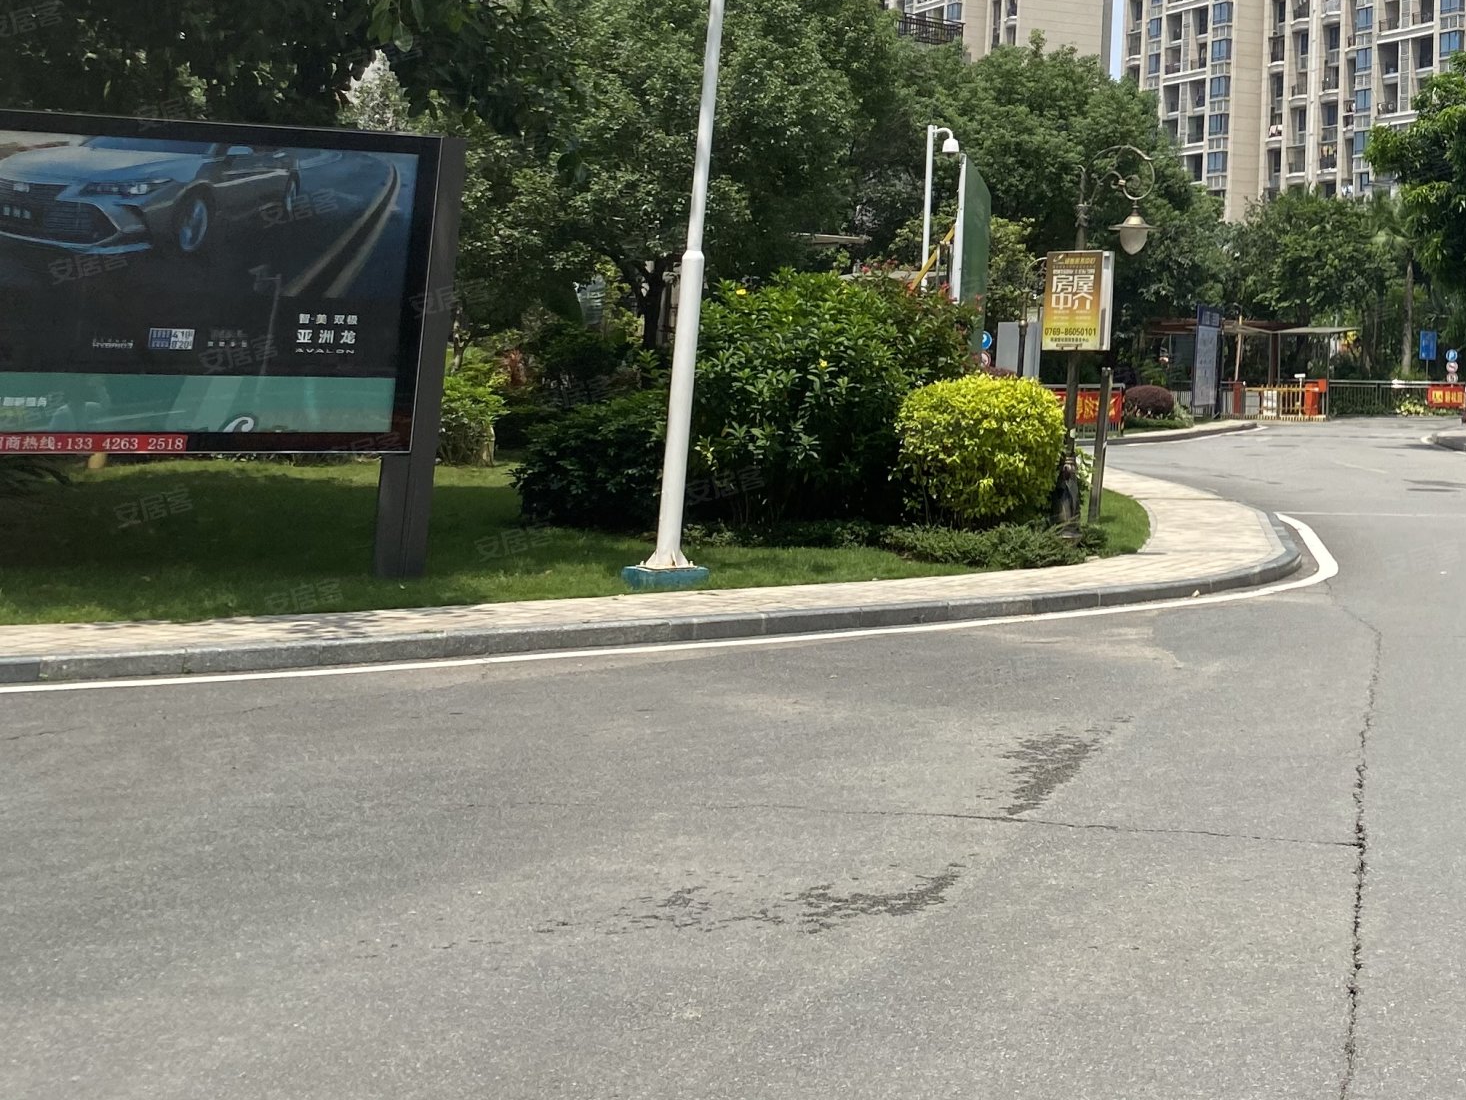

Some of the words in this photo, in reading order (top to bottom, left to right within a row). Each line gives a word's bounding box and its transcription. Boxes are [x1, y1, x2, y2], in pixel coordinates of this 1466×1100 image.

[1052, 274, 1095, 293] 房屋
[1051, 293, 1093, 310] 中介
[296, 329, 357, 344] 亚洲龙
[1044, 327, 1097, 336] 0769-86050101
[102, 437, 138, 450] 4263
[147, 437, 183, 450] 2518
